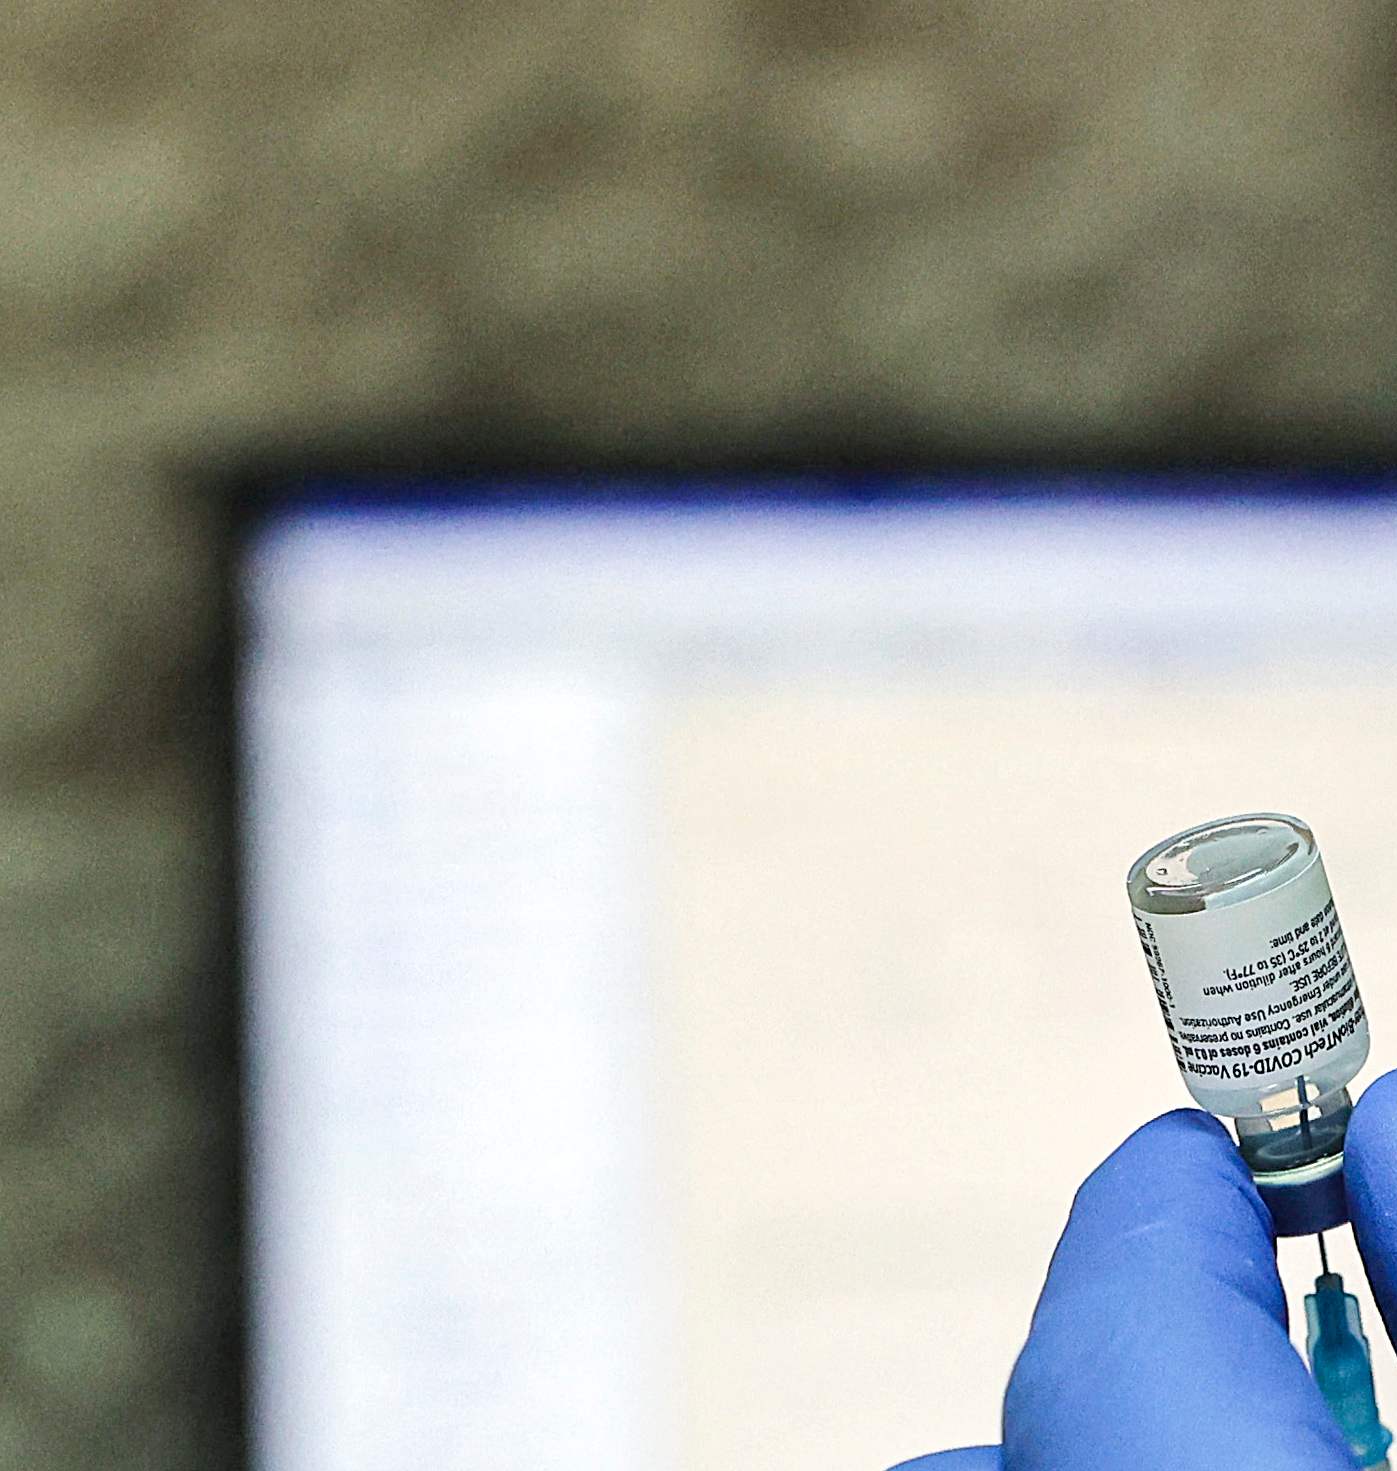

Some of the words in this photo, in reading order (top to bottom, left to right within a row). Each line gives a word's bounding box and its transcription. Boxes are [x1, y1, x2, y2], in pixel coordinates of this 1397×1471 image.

[1309, 910, 1324, 927] date
[1293, 921, 1309, 939] and
[1268, 930, 1294, 949] time:
[1309, 935, 1318, 945] to
[1269, 951, 1286, 968] (35
[1286, 940, 1309, 961] 25°C
[1301, 945, 1326, 966] hours
[1222, 964, 1255, 981] 77°F).
[1256, 959, 1268, 970] to
[1277, 961, 1301, 978] after
[1310, 955, 1338, 982] BEFORE
[1202, 984, 1233, 996] when
[1234, 972, 1275, 991] dilution
[1288, 974, 1311, 992] USE.
[1321, 971, 1340, 992] under
[1267, 986, 1321, 1015] Emergency
[1243, 1009, 1266, 1022] Use
[1291, 1007, 1312, 1023] use.
[1244, 1018, 1290, 1039] Contains
[1309, 1017, 1328, 1036] vial
[1230, 1031, 1243, 1041] no
[1261, 1027, 1309, 1050] contains
[1207, 1049, 1218, 1061] of
[1218, 1044, 1252, 1058] doses
[1252, 1042, 1261, 1055] 6
[1186, 1061, 1231, 1079] Vaccine
[1232, 1048, 1302, 1078] COVID-19
